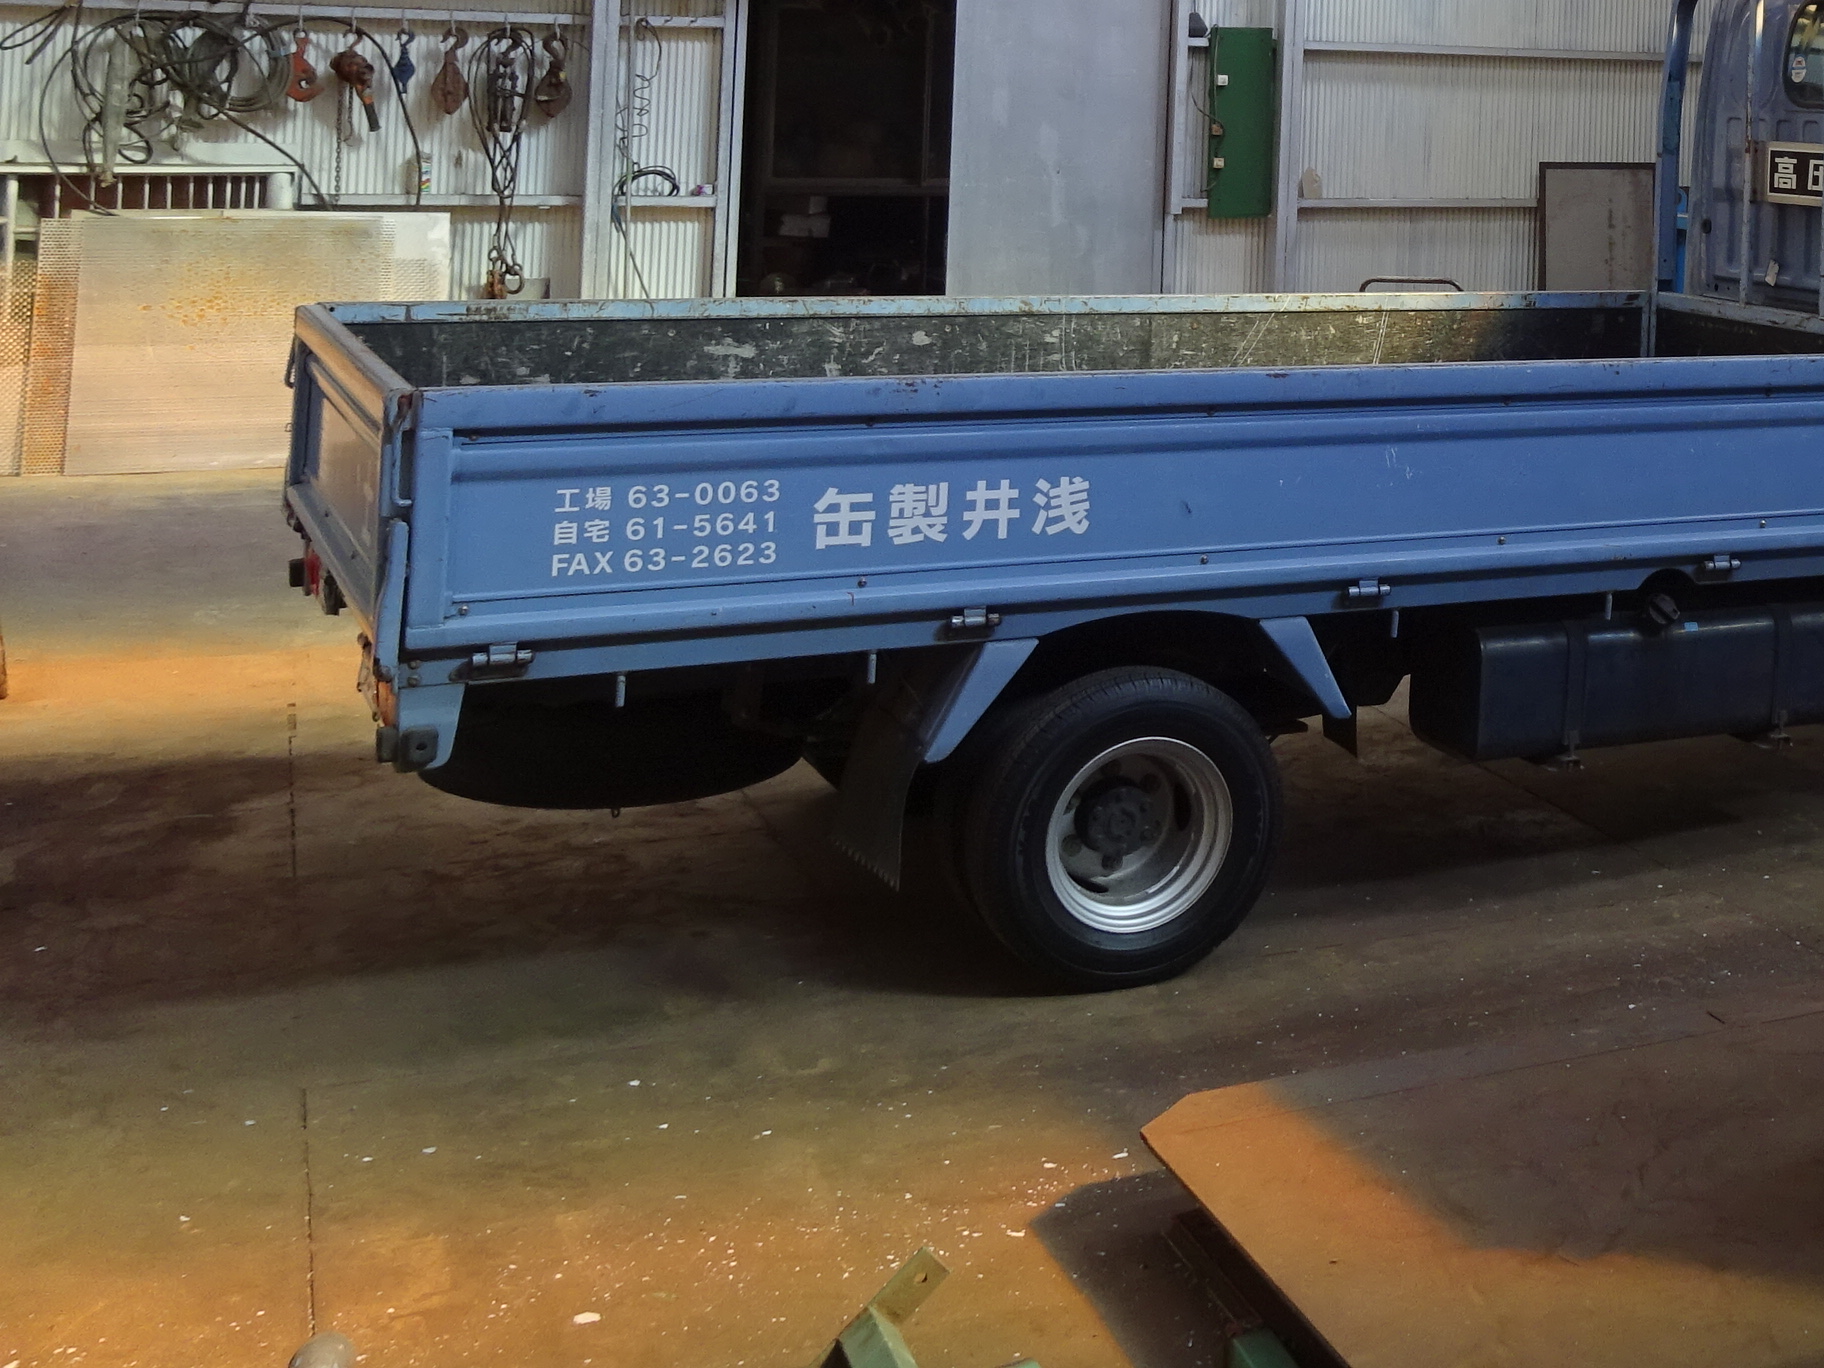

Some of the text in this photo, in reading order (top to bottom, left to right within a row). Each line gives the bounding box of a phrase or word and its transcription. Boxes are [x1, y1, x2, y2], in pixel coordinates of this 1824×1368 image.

[554, 479, 780, 513] 工場 63-0063
[553, 510, 777, 545] 自宅 61-5641
[551, 541, 777, 577] FAX 63-2623
